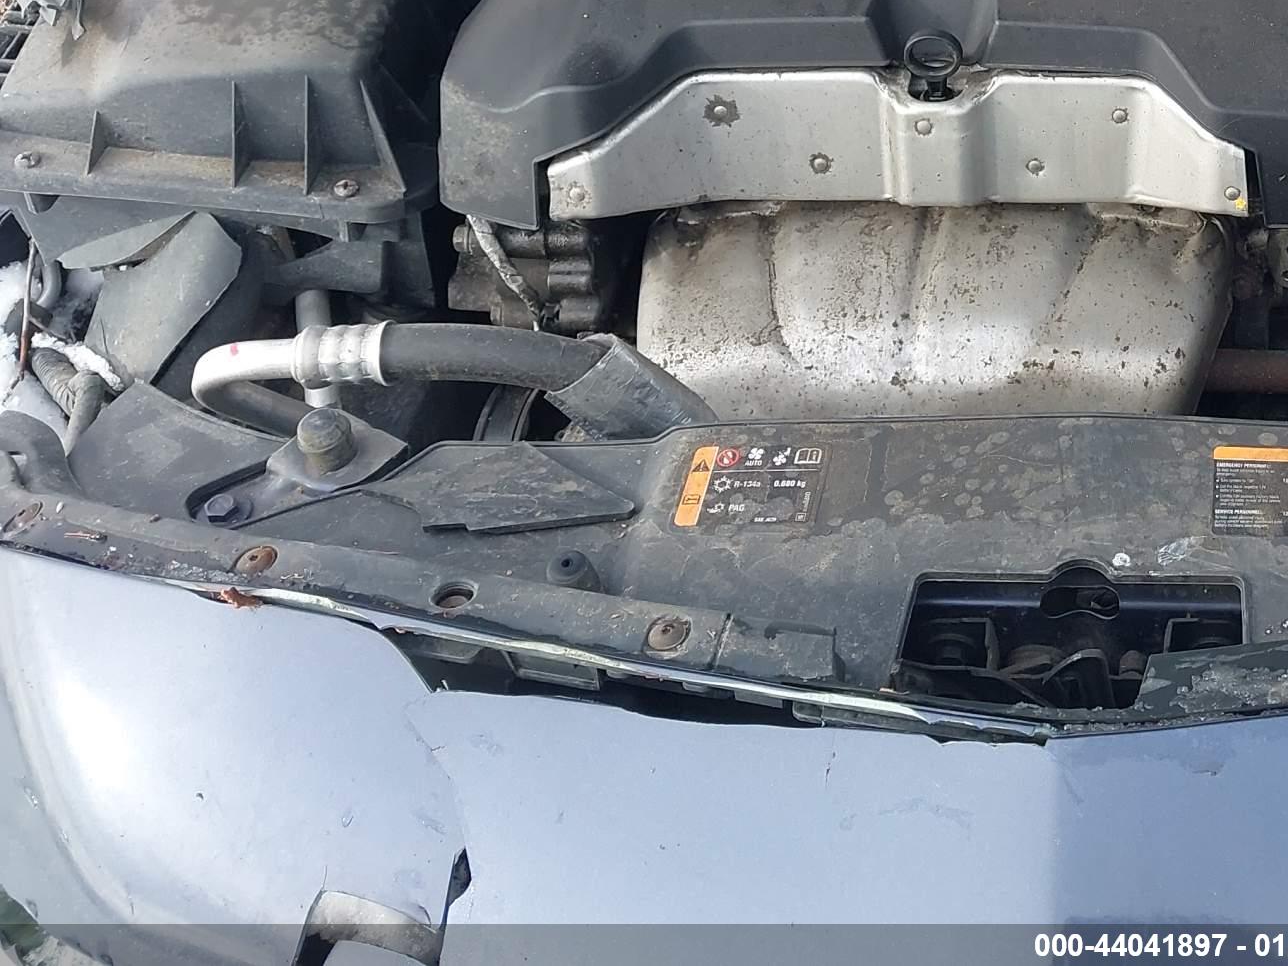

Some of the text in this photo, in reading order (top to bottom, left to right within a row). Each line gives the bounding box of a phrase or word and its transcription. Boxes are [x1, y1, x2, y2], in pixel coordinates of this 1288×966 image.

[734, 480, 761, 488] R-134a
[797, 480, 807, 489] kg
[728, 504, 745, 512] PAG
